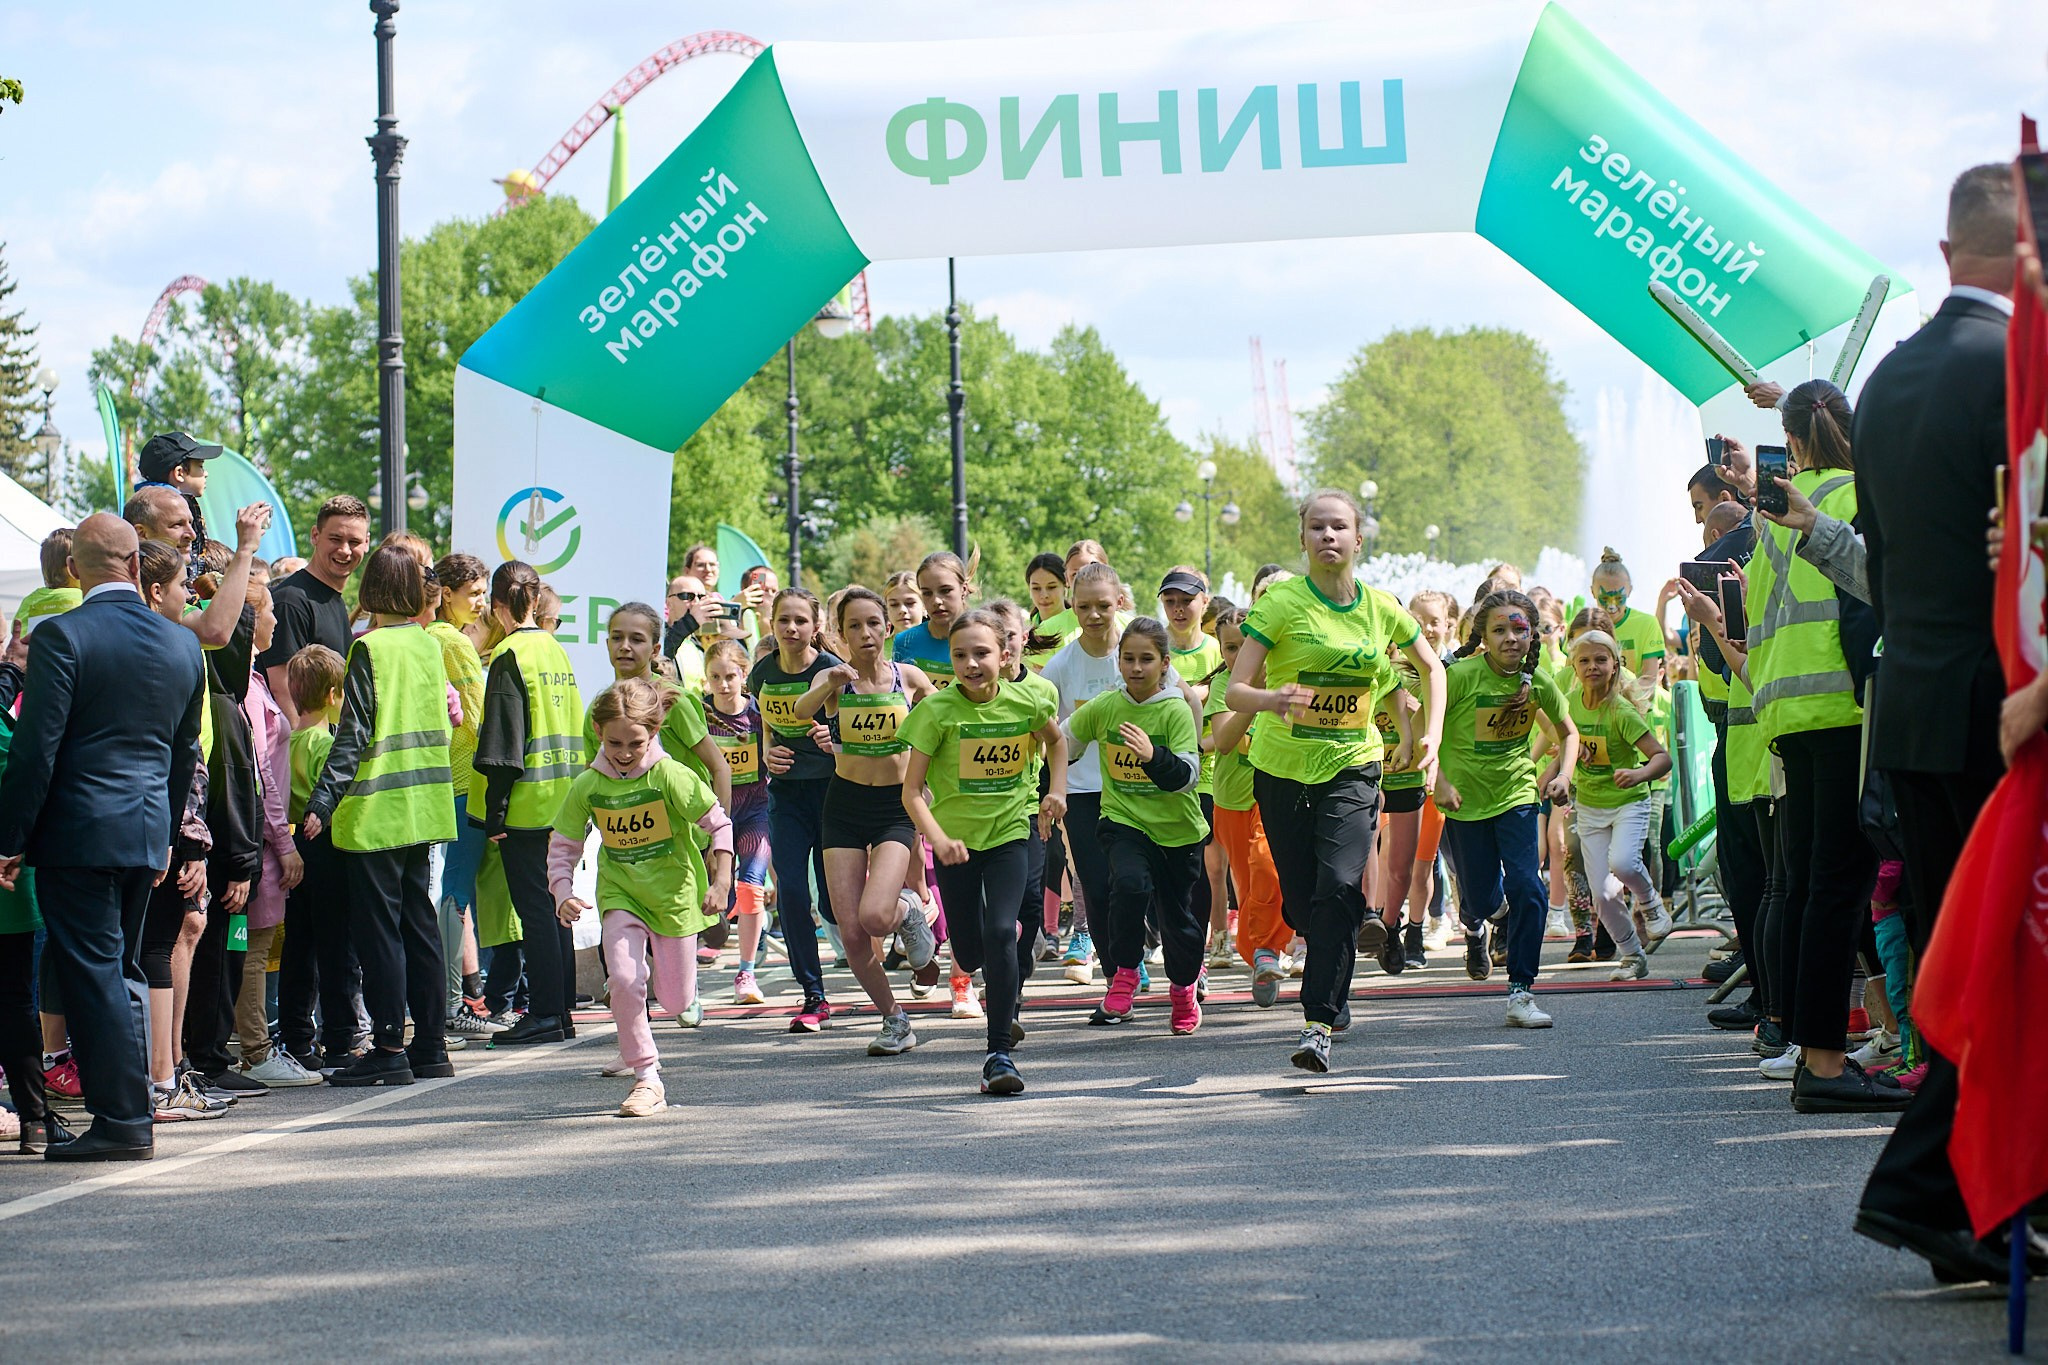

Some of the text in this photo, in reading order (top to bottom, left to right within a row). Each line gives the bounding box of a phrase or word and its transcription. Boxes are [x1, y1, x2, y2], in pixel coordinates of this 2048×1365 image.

[885, 78, 1407, 185] ФИНИШ
[578, 167, 739, 333] зелёный
[1550, 166, 1732, 318] марафон
[1579, 134, 1766, 285] зелёный
[605, 201, 769, 365] марафон
[851, 712, 897, 731] 4471
[973, 743, 1020, 764] 4436
[1308, 694, 1358, 714] 4408
[607, 811, 655, 835] 4466
